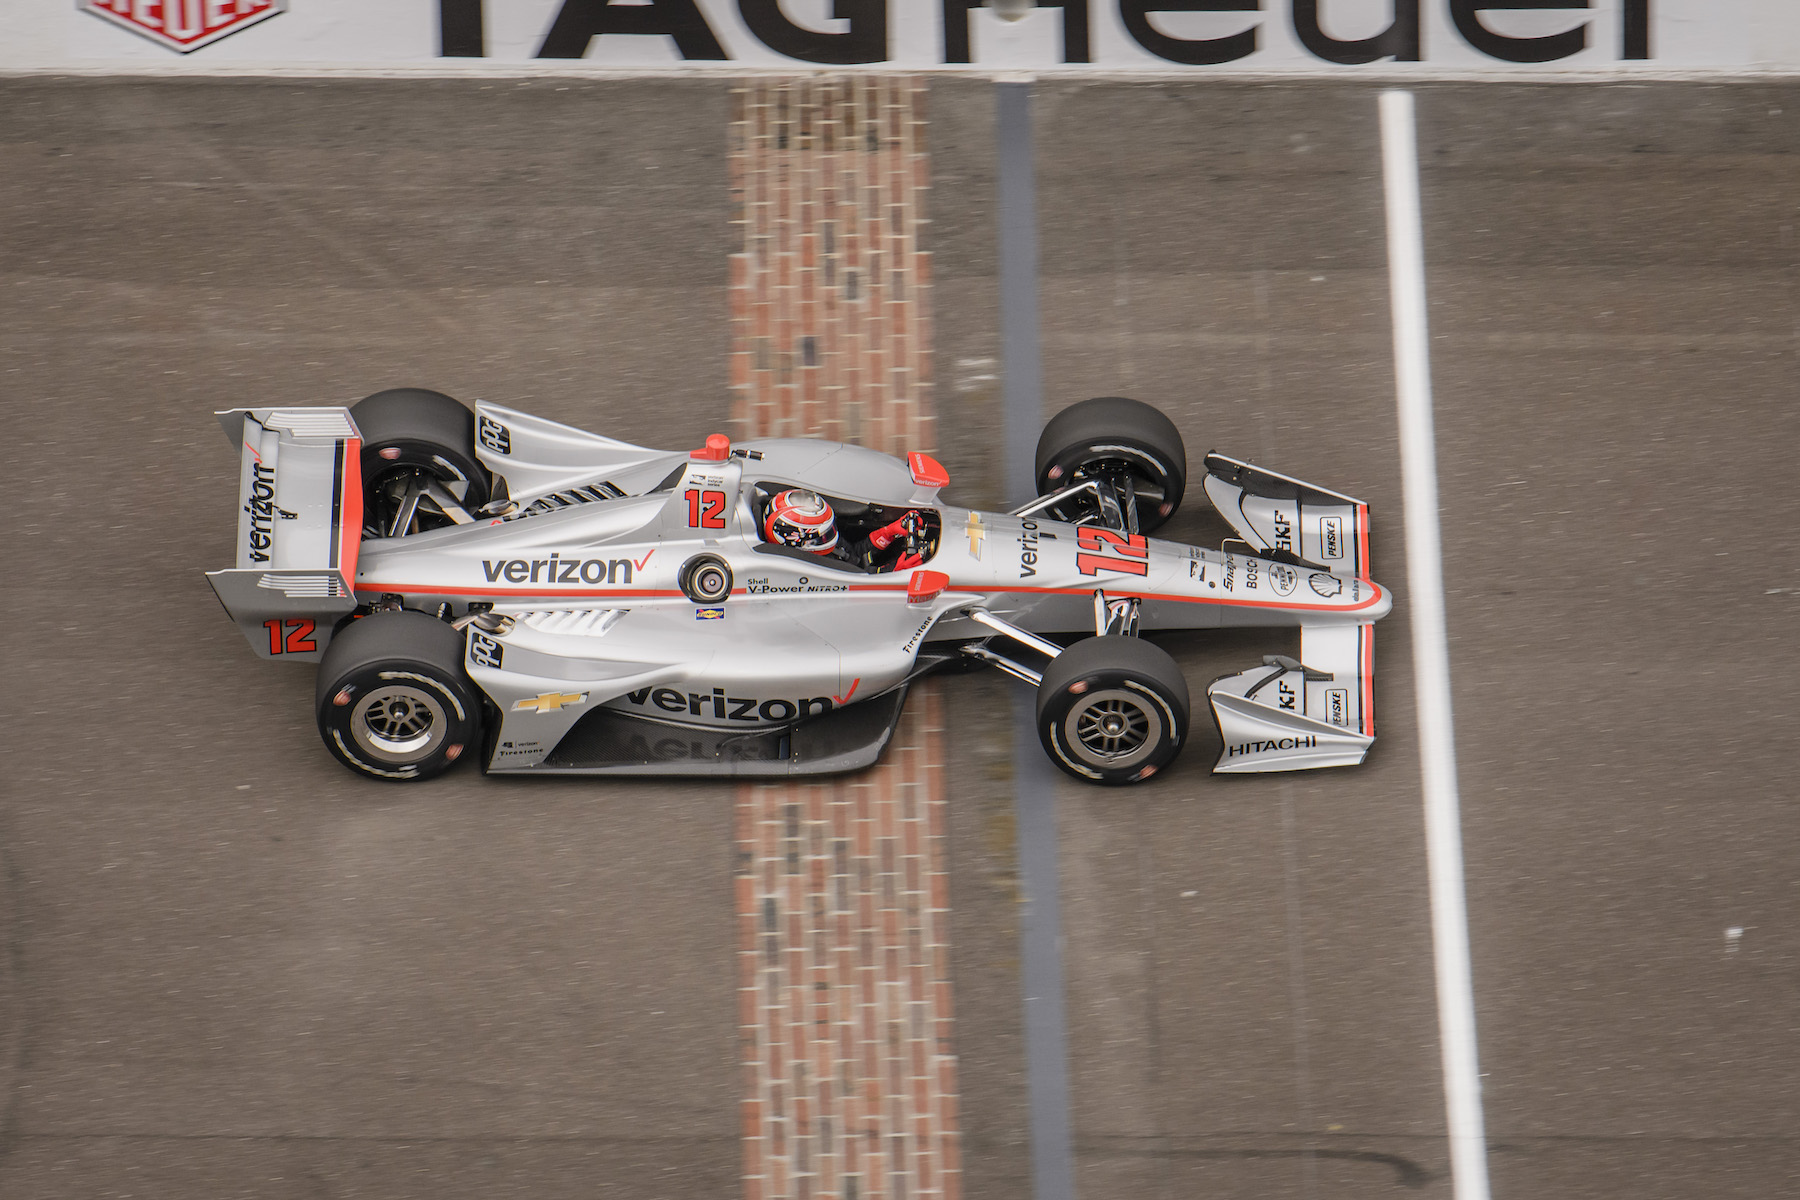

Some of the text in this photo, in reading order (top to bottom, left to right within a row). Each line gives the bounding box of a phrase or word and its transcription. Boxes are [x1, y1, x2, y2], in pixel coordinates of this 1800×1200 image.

[684, 488, 726, 529] 12
[1076, 526, 1149, 577] 12
[1326, 519, 1337, 557] PENSKE
[482, 552, 633, 585] verizon
[748, 585, 804, 594] V-Power
[263, 619, 317, 656] 12
[902, 616, 933, 655] Firestone
[626, 685, 834, 722] verizon
[1278, 679, 1295, 712] KF
[500, 748, 544, 757] Firestone
[1228, 735, 1317, 758] HITACHI
